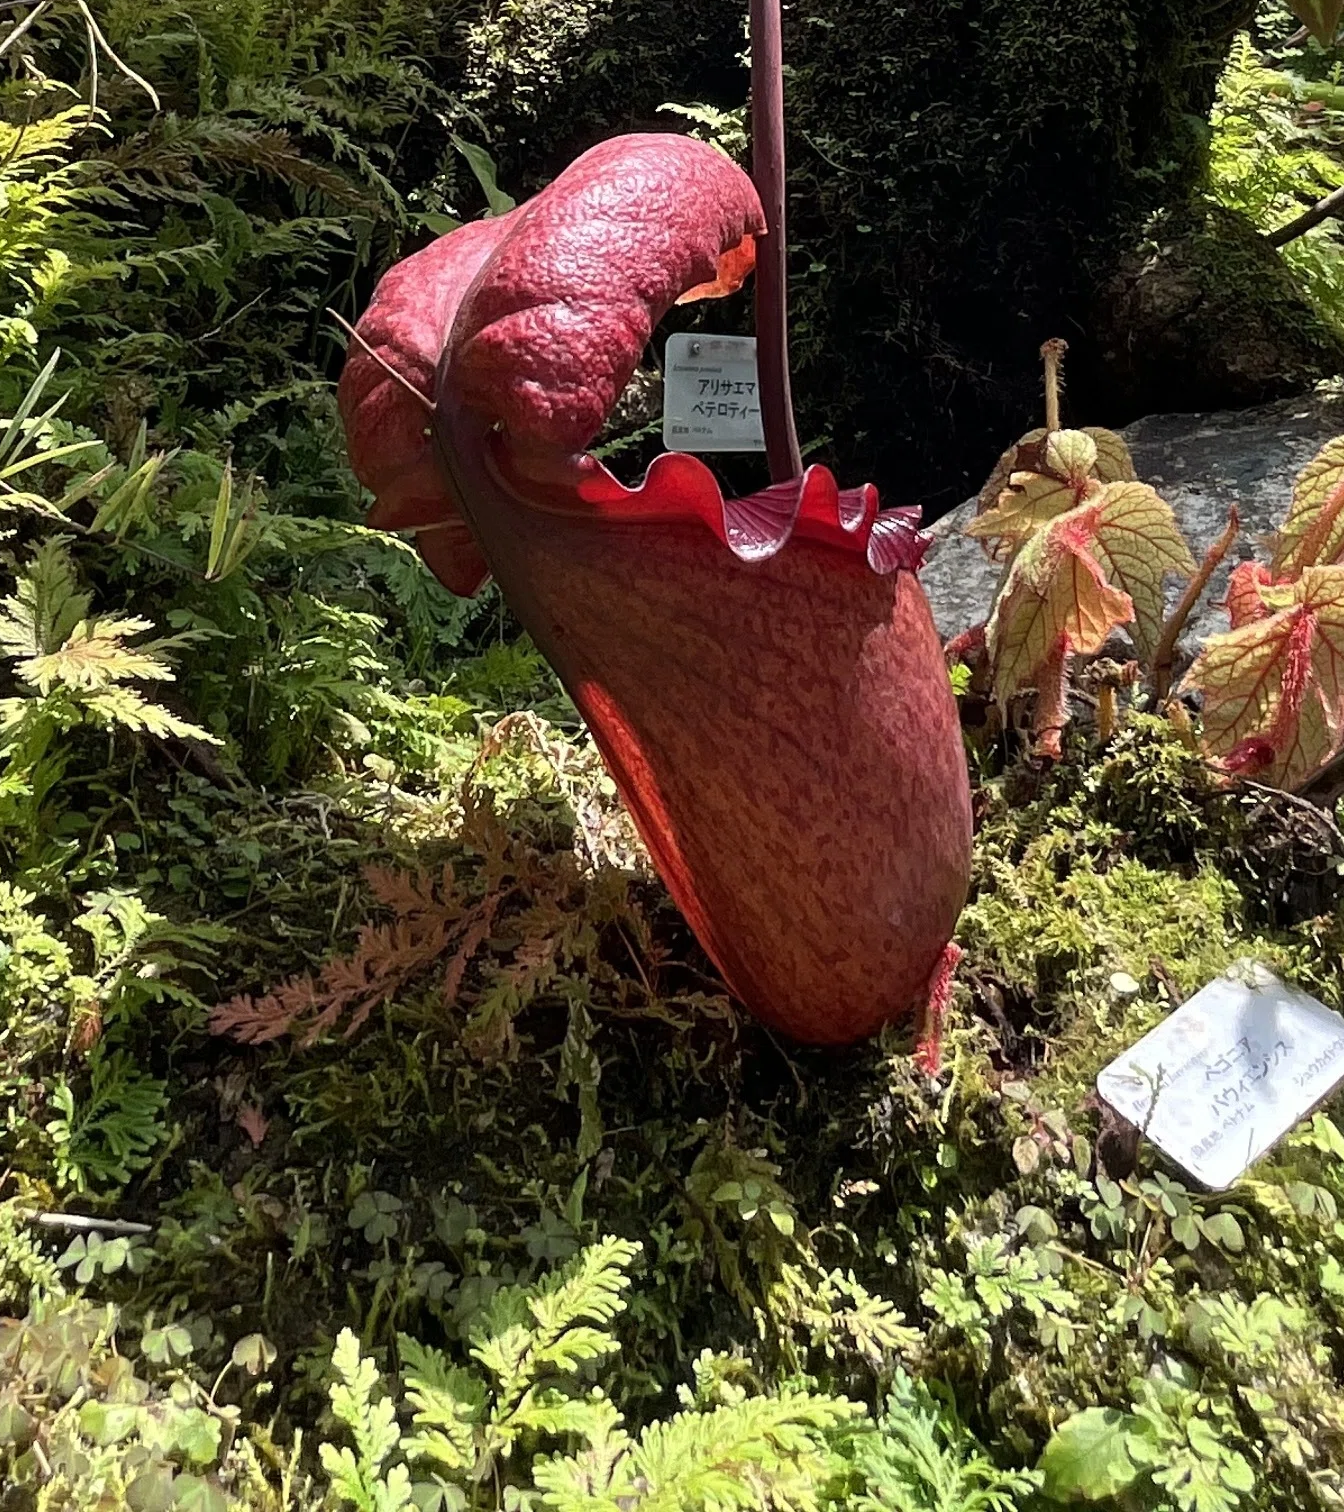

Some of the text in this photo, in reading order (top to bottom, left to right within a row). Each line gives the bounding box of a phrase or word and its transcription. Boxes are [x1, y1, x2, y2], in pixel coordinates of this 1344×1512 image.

[698, 379, 756, 396] アリサエマ
[690, 401, 760, 419] ペテロティー
[1206, 1036, 1252, 1082] ベゴニア
